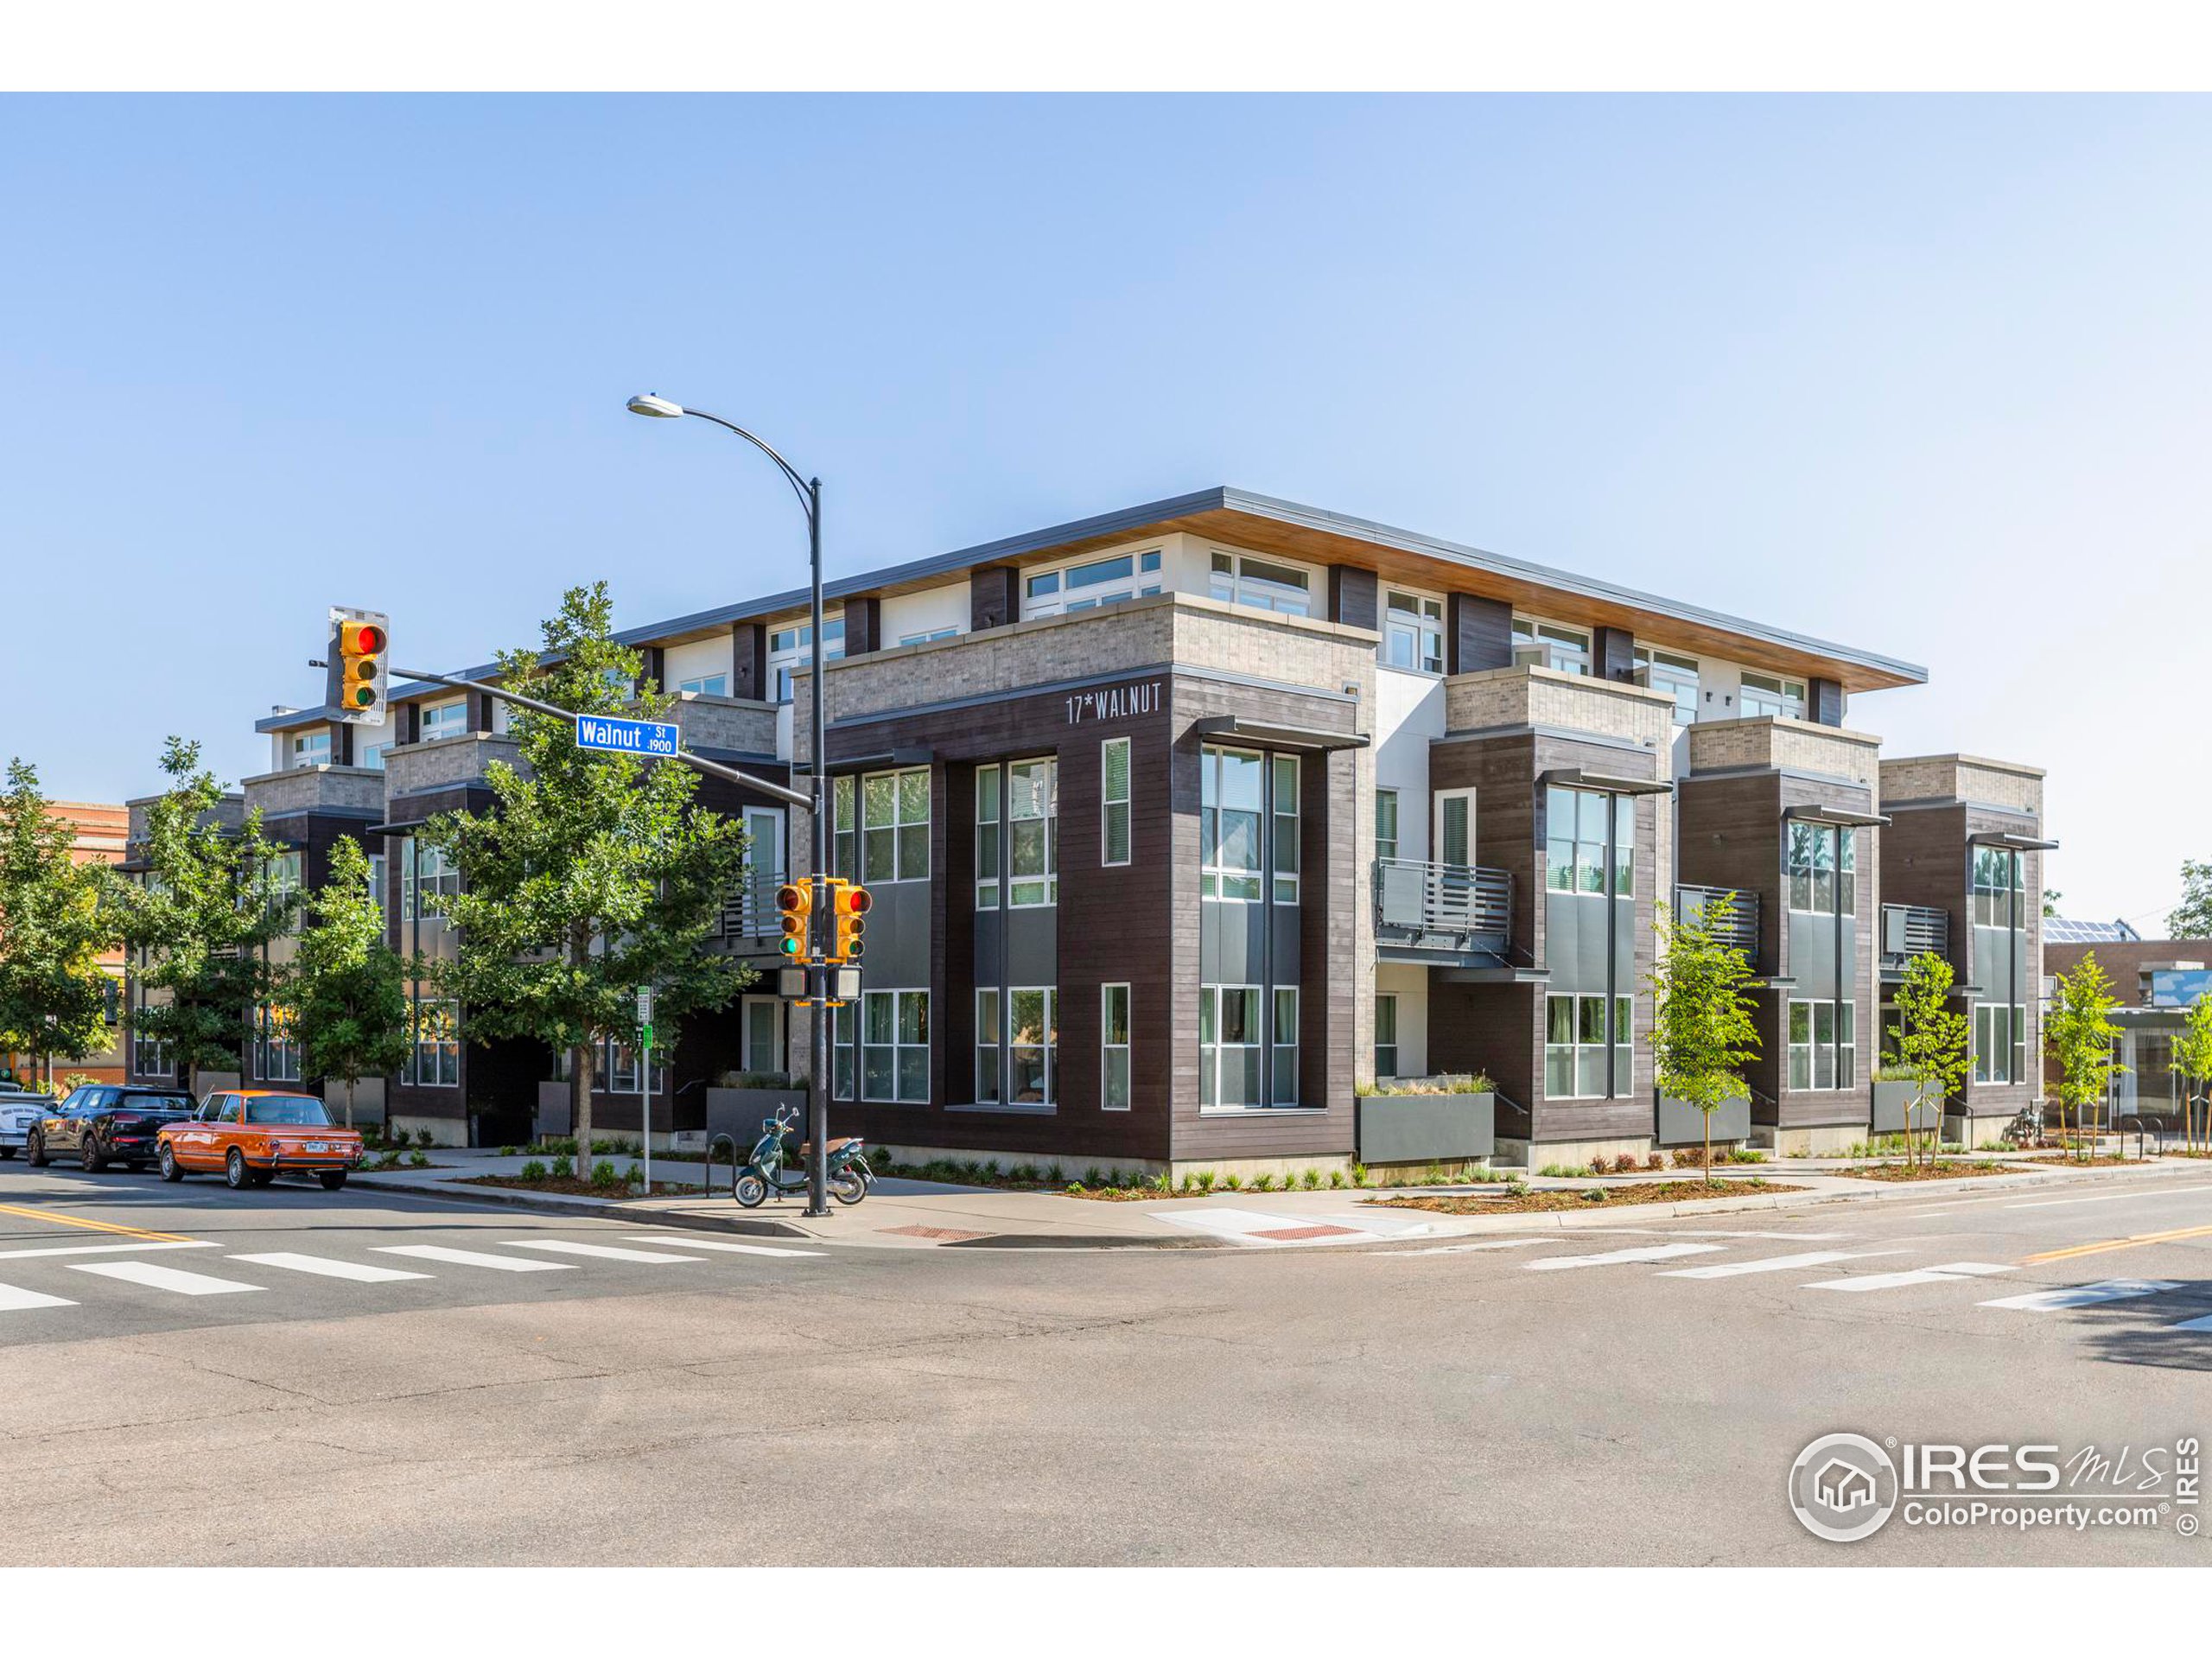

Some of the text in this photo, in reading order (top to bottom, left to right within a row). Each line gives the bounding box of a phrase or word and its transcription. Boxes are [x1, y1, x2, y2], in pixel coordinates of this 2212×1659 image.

[582, 721, 665, 747] Walnut St
[649, 739, 671, 753] 1900
